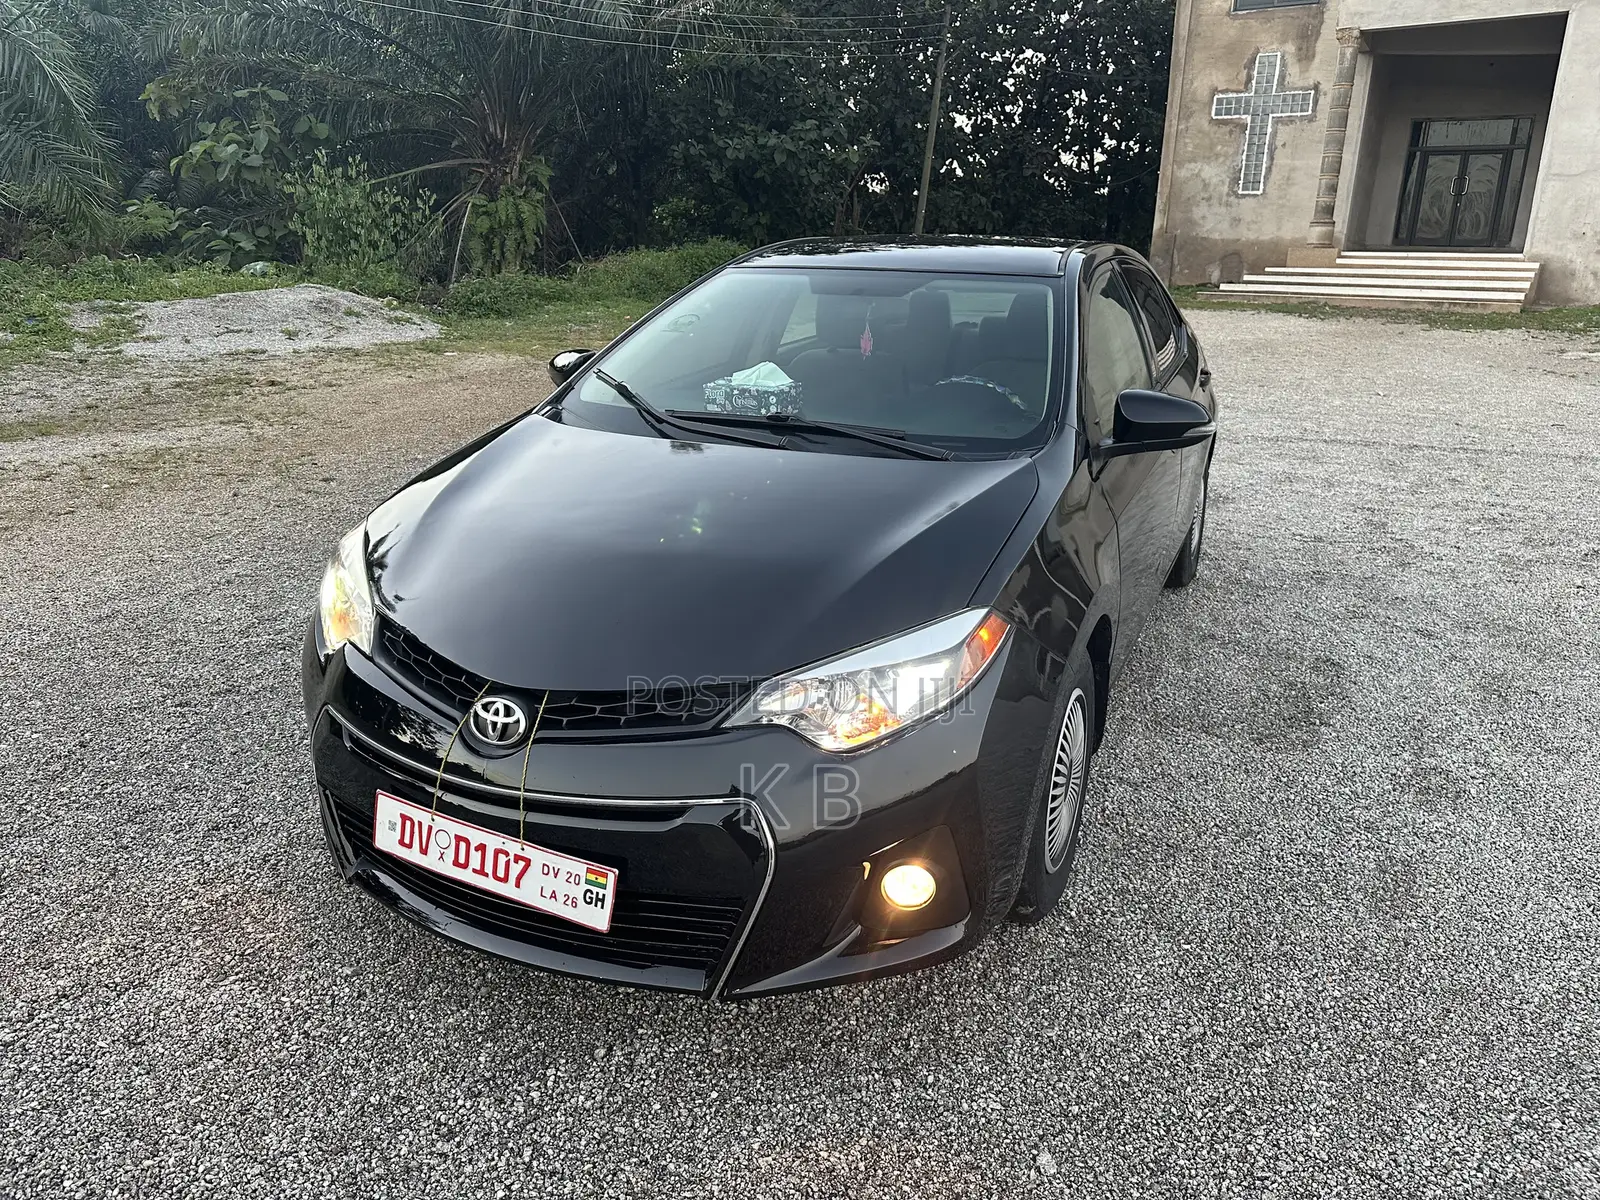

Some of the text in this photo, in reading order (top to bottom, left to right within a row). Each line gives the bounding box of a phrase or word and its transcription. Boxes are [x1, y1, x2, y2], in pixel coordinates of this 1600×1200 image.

[398, 812, 532, 889] DV D107
[541, 863, 581, 886] DV 20
[540, 886, 578, 909] LA 26
[582, 888, 606, 910] GH
